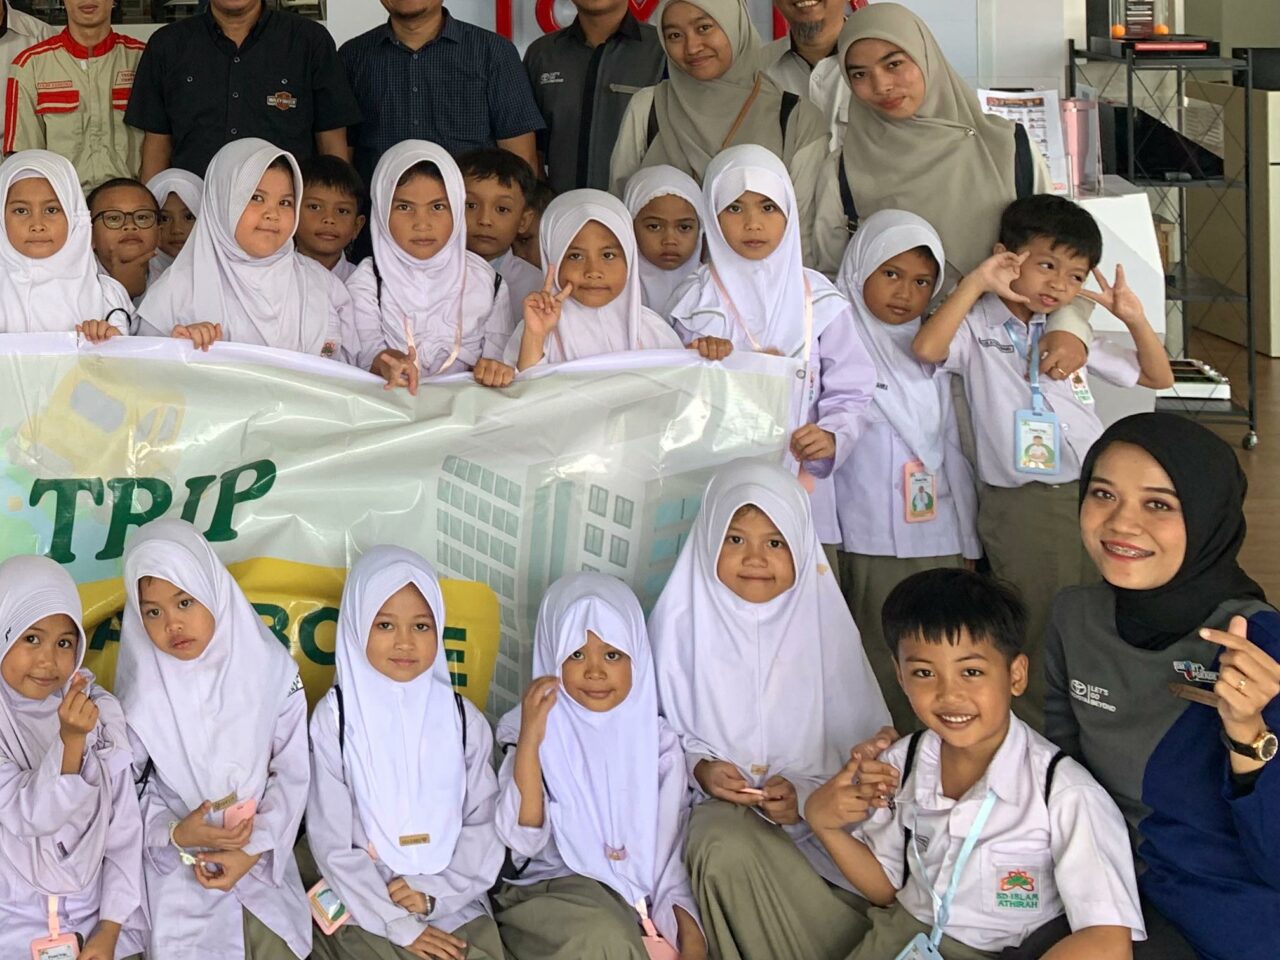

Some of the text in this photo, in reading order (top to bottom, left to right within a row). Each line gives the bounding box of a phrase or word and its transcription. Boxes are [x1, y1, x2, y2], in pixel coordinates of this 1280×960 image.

[29, 458, 277, 565] TRIP
[1090, 685, 1109, 696] LET'S
[1090, 700, 1117, 713] BEYOND
